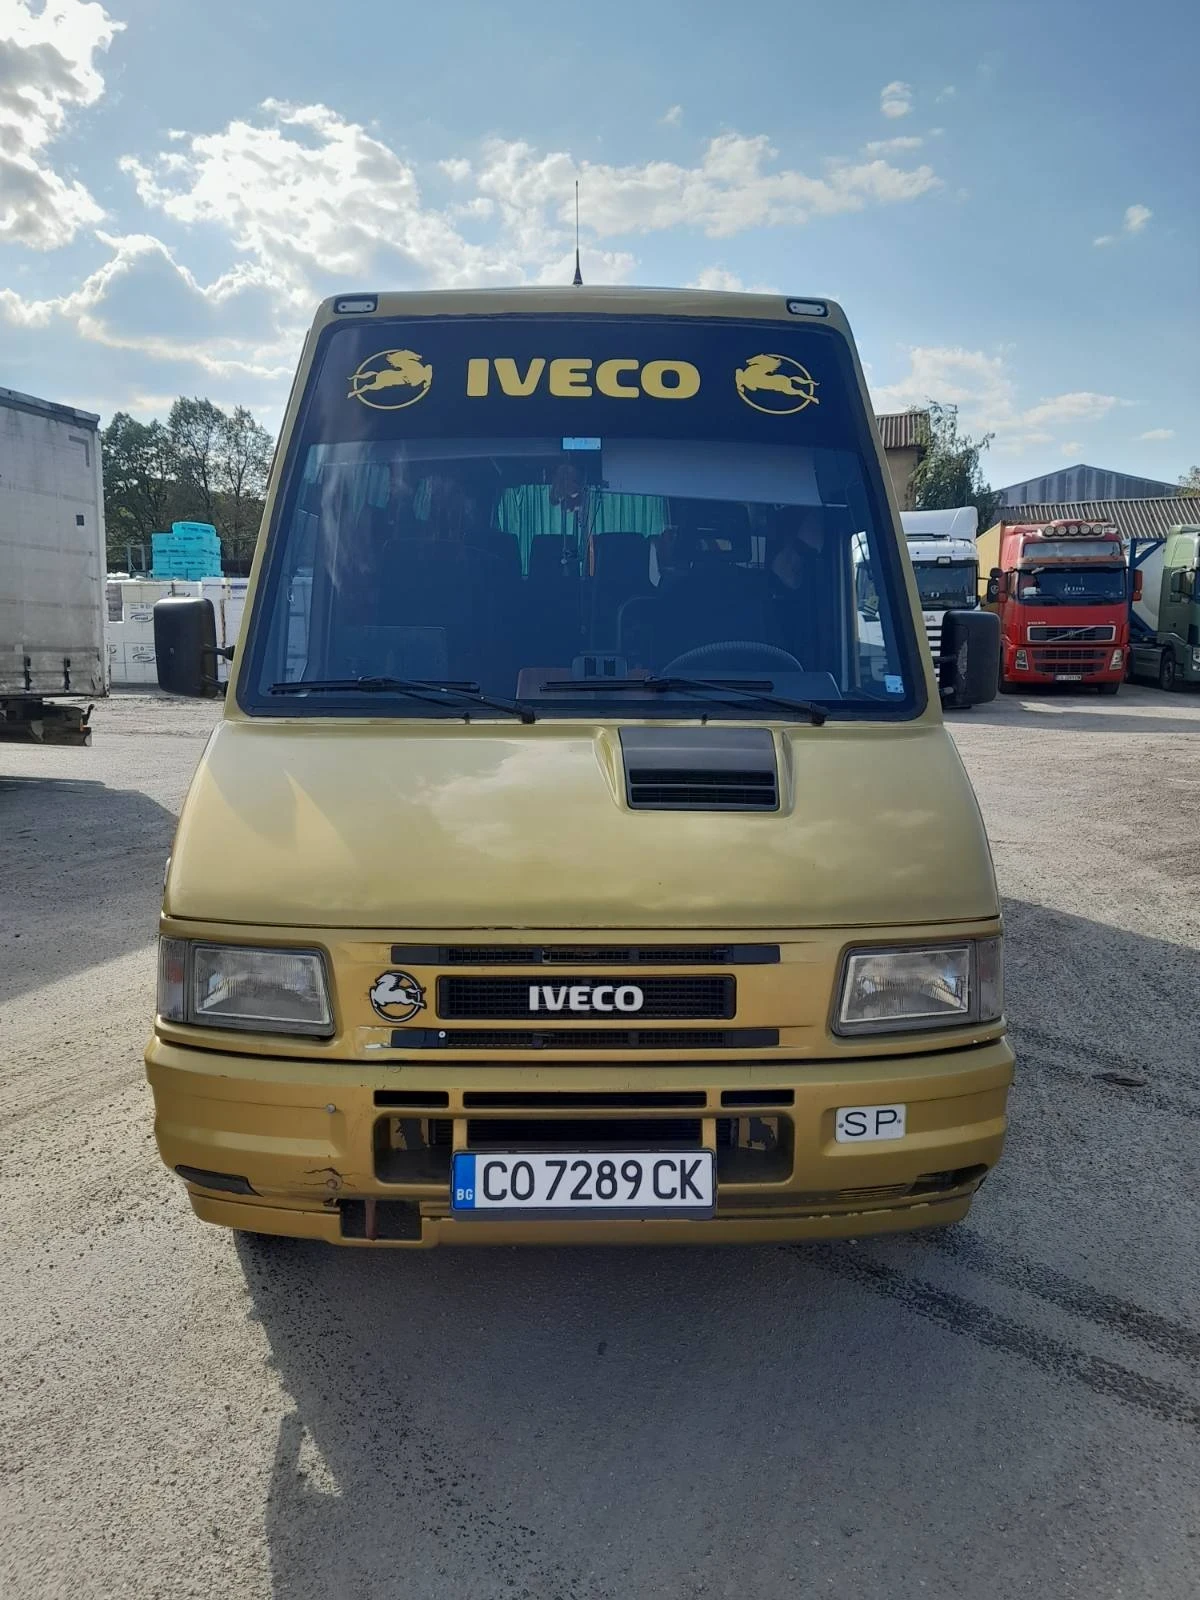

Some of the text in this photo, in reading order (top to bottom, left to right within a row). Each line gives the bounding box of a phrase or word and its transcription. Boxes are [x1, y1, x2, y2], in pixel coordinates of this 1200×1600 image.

[466, 358, 701, 399] IVECO
[529, 985, 644, 1012] IVECO
[844, 1109, 901, 1138] SP
[456, 1189, 473, 1201] BG
